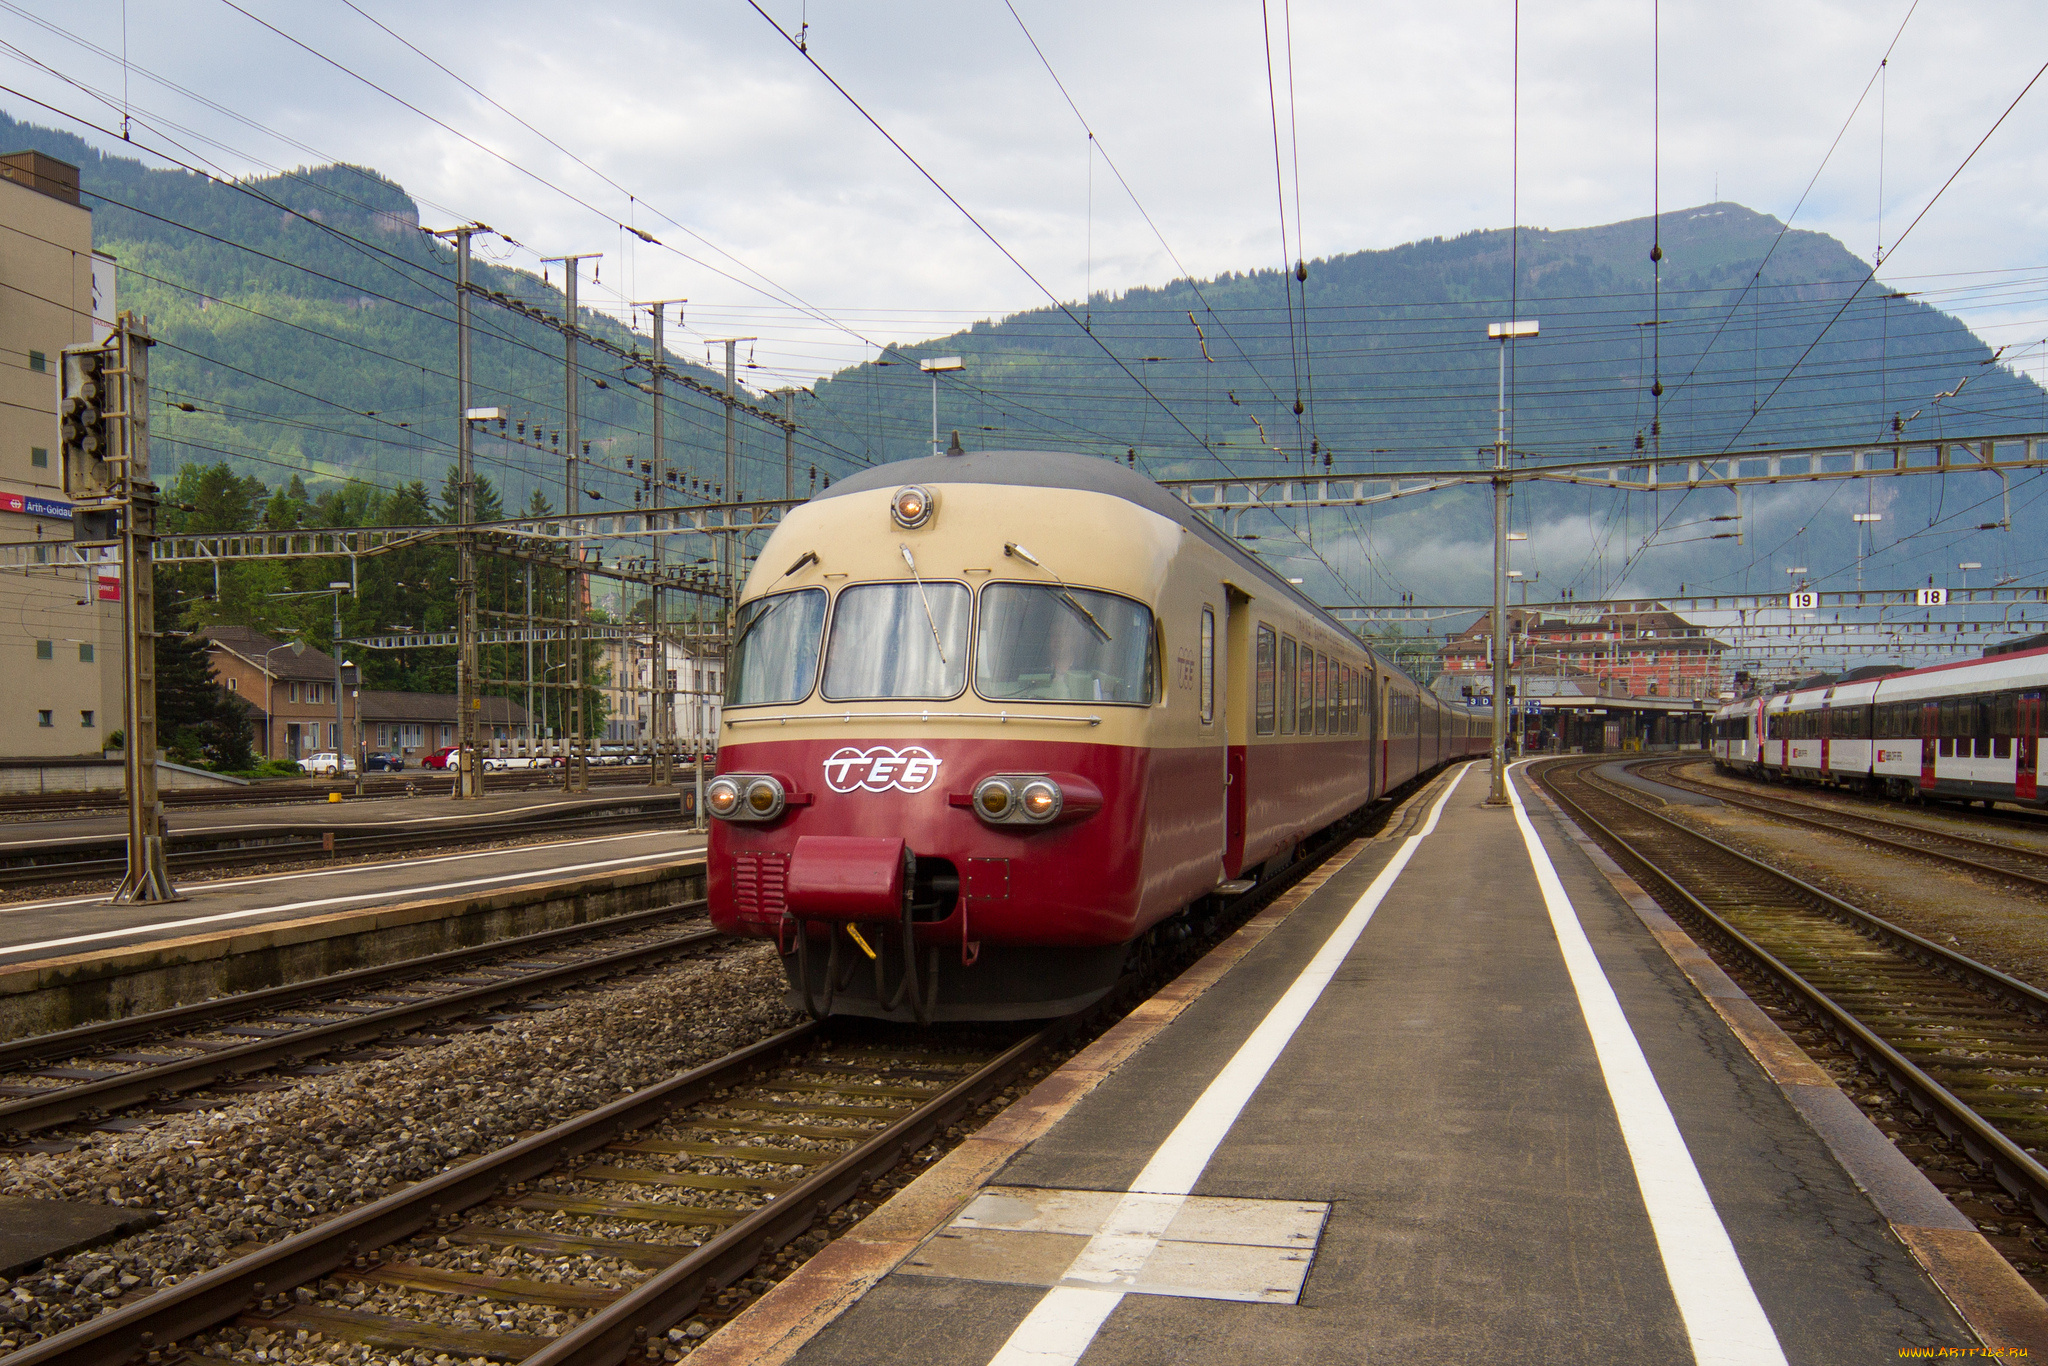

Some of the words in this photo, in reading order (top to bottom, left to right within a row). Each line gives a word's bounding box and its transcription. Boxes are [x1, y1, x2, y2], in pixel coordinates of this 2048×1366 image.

[27, 501, 73, 518] Arth-Goldau
[1795, 594, 1812, 607] 19
[1924, 591, 1941, 604] 18
[1470, 697, 1477, 705] 3
[1482, 697, 1489, 705] D
[823, 755, 943, 784] TEE
